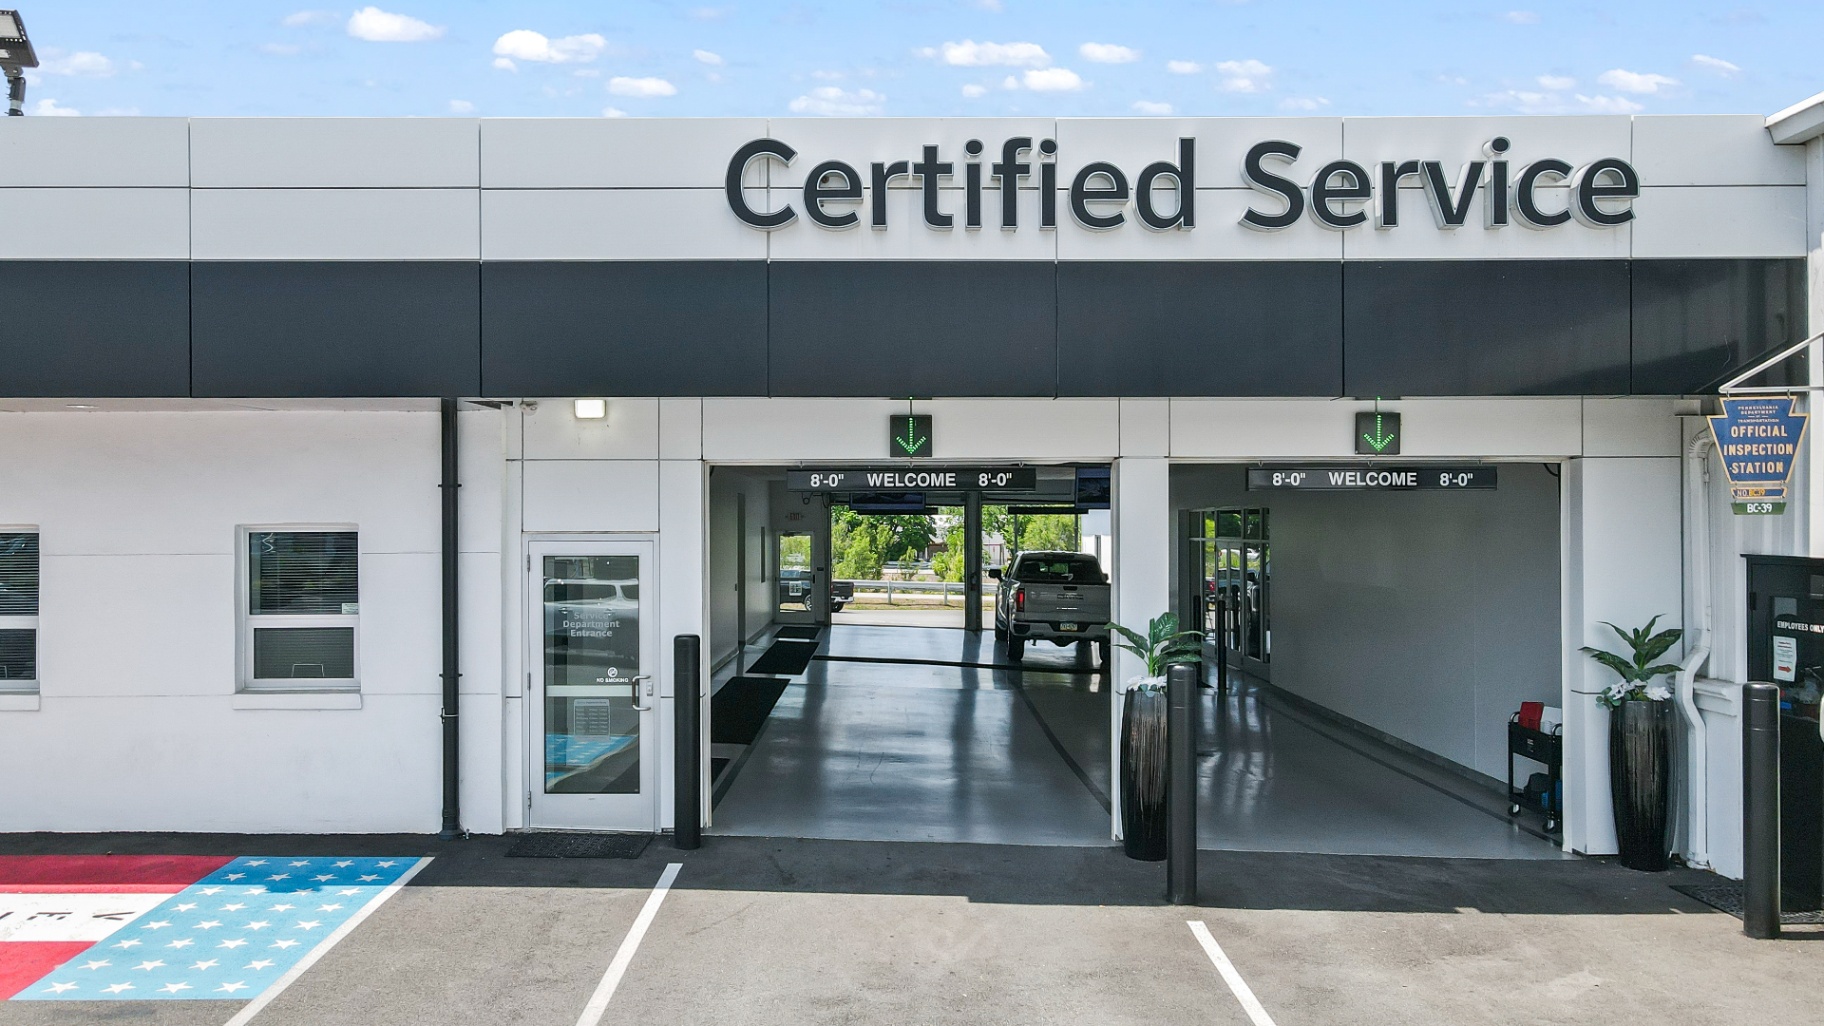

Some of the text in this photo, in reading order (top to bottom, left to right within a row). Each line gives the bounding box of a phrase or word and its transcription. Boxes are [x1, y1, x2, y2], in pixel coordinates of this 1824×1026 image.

[725, 136, 1641, 232] Certified Service
[1731, 425, 1788, 438] OFFICIAL
[1723, 443, 1794, 456] INSPECTION
[1731, 461, 1784, 474] STATION
[809, 472, 1012, 488] 8'-0" WELCOME 8'-0"
[1272, 471, 1474, 487] 8'-0" WELCOME 8'-0"
[1746, 503, 1773, 513] BC-39
[573, 611, 609, 620] Service
[562, 620, 620, 630] Department
[1777, 621, 1824, 633] EMPLOYEES ONLY
[570, 629, 613, 637] Entrance
